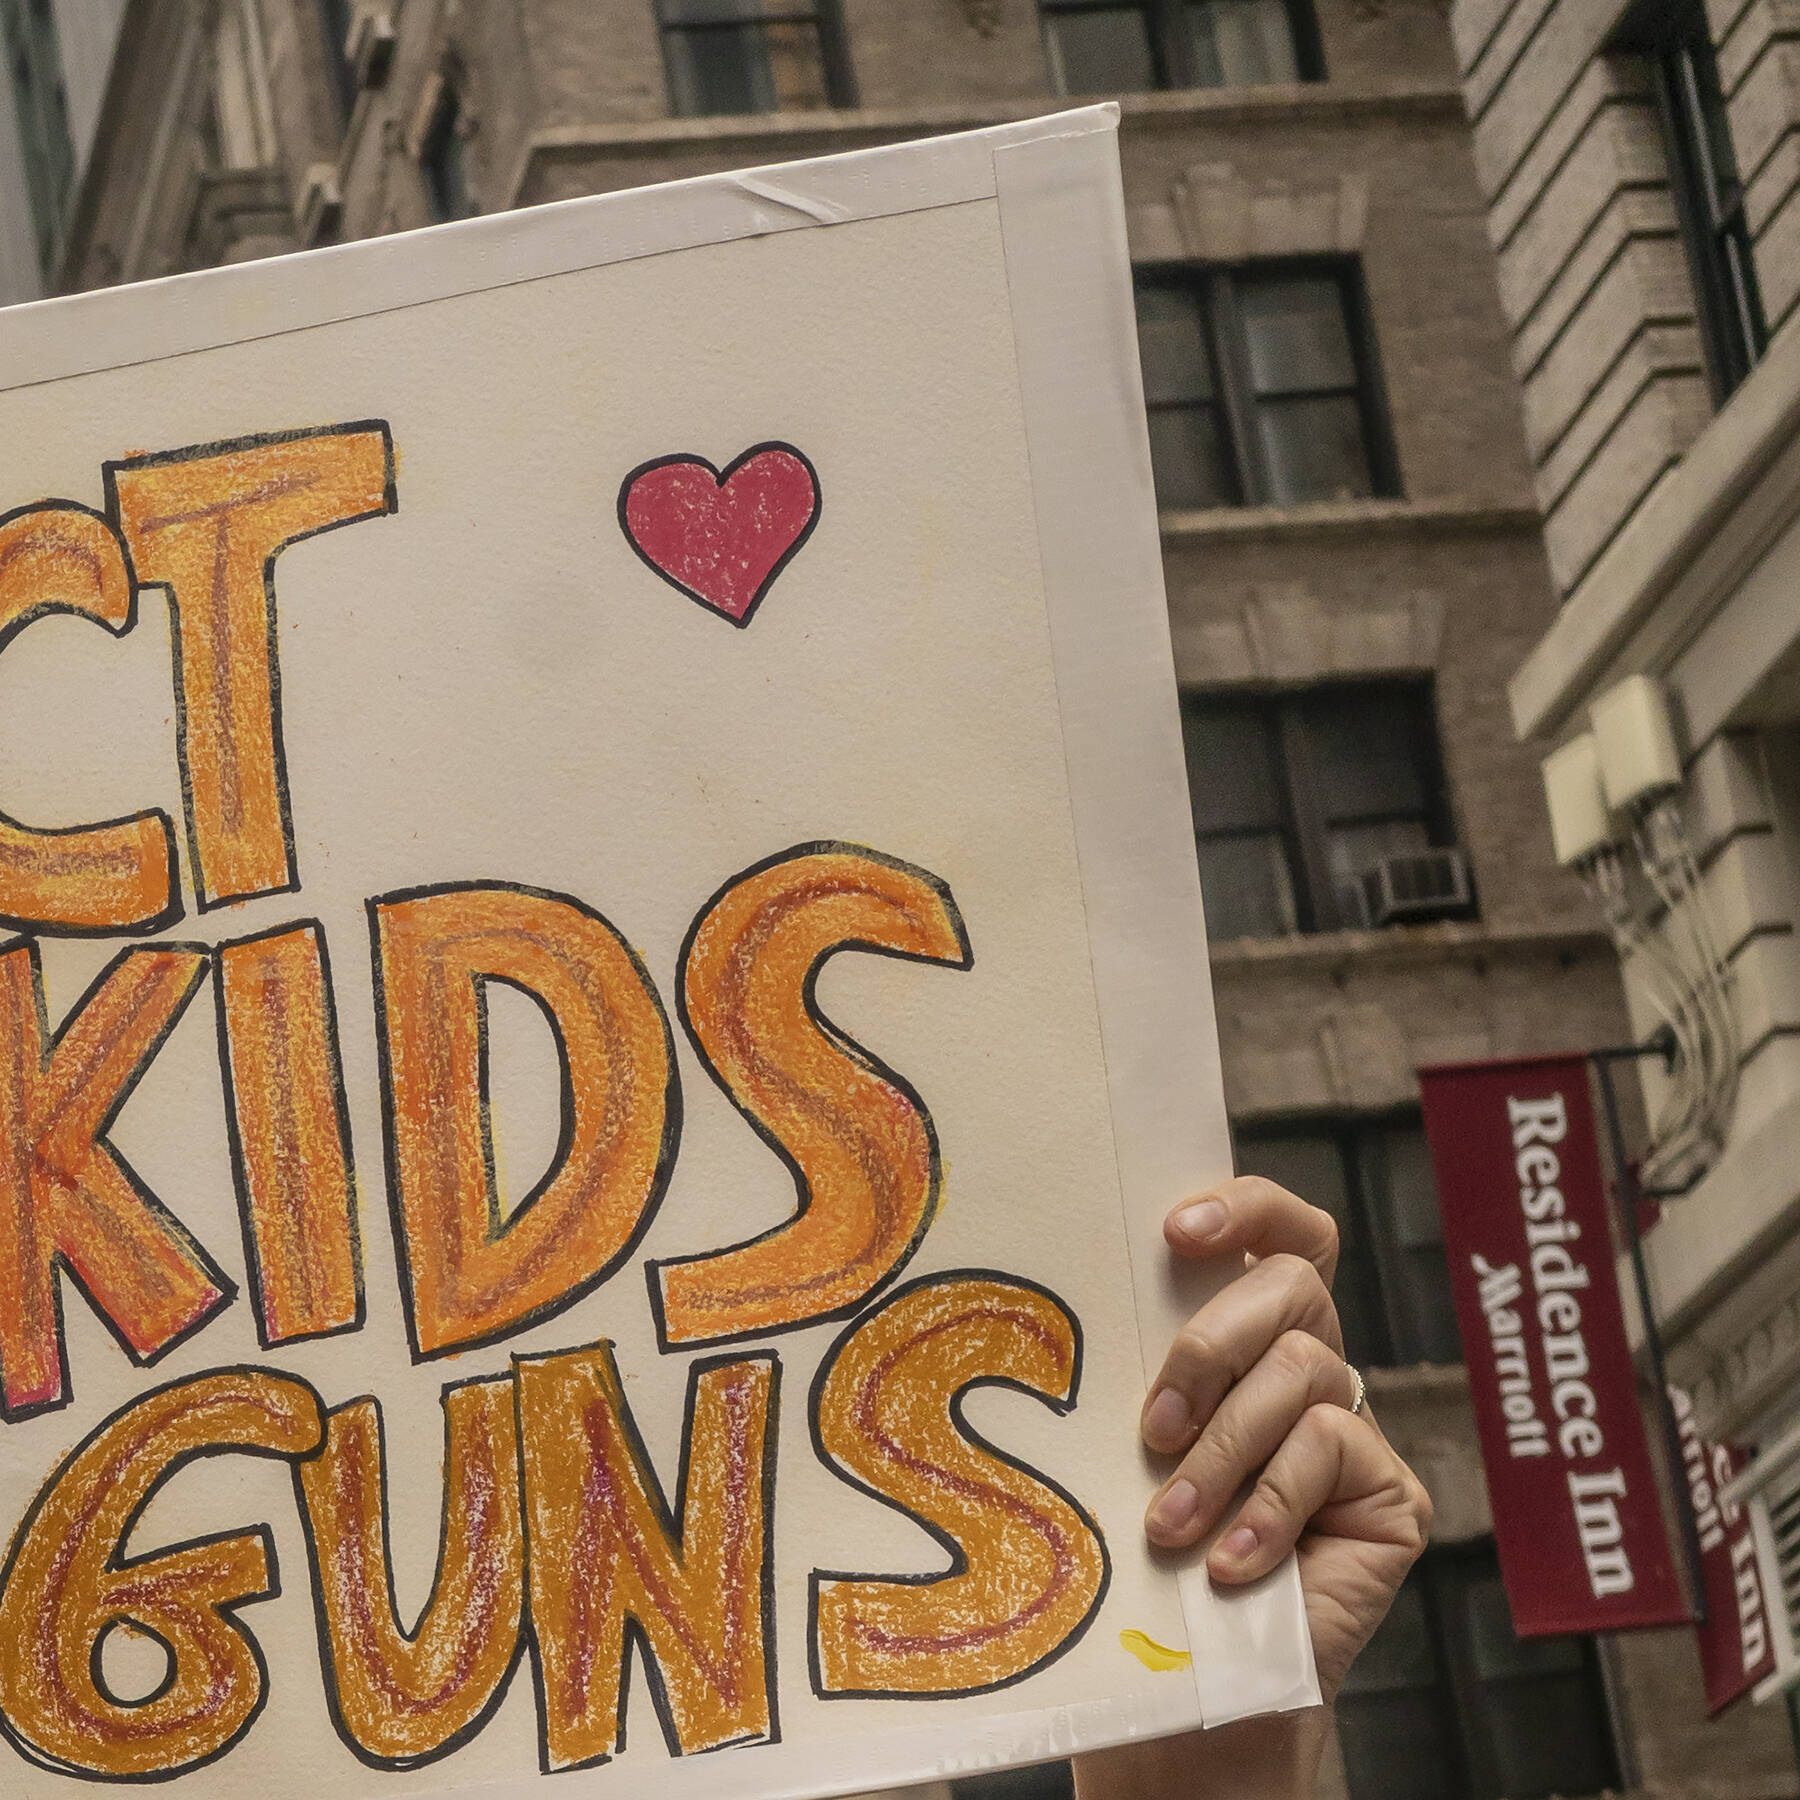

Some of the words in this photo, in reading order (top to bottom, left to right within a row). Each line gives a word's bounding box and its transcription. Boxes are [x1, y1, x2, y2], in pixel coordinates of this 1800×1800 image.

[1470, 1252, 1551, 1458] Marriott
[1506, 1092, 1605, 1459] Residence
[1567, 1466, 1635, 1599] Inn
